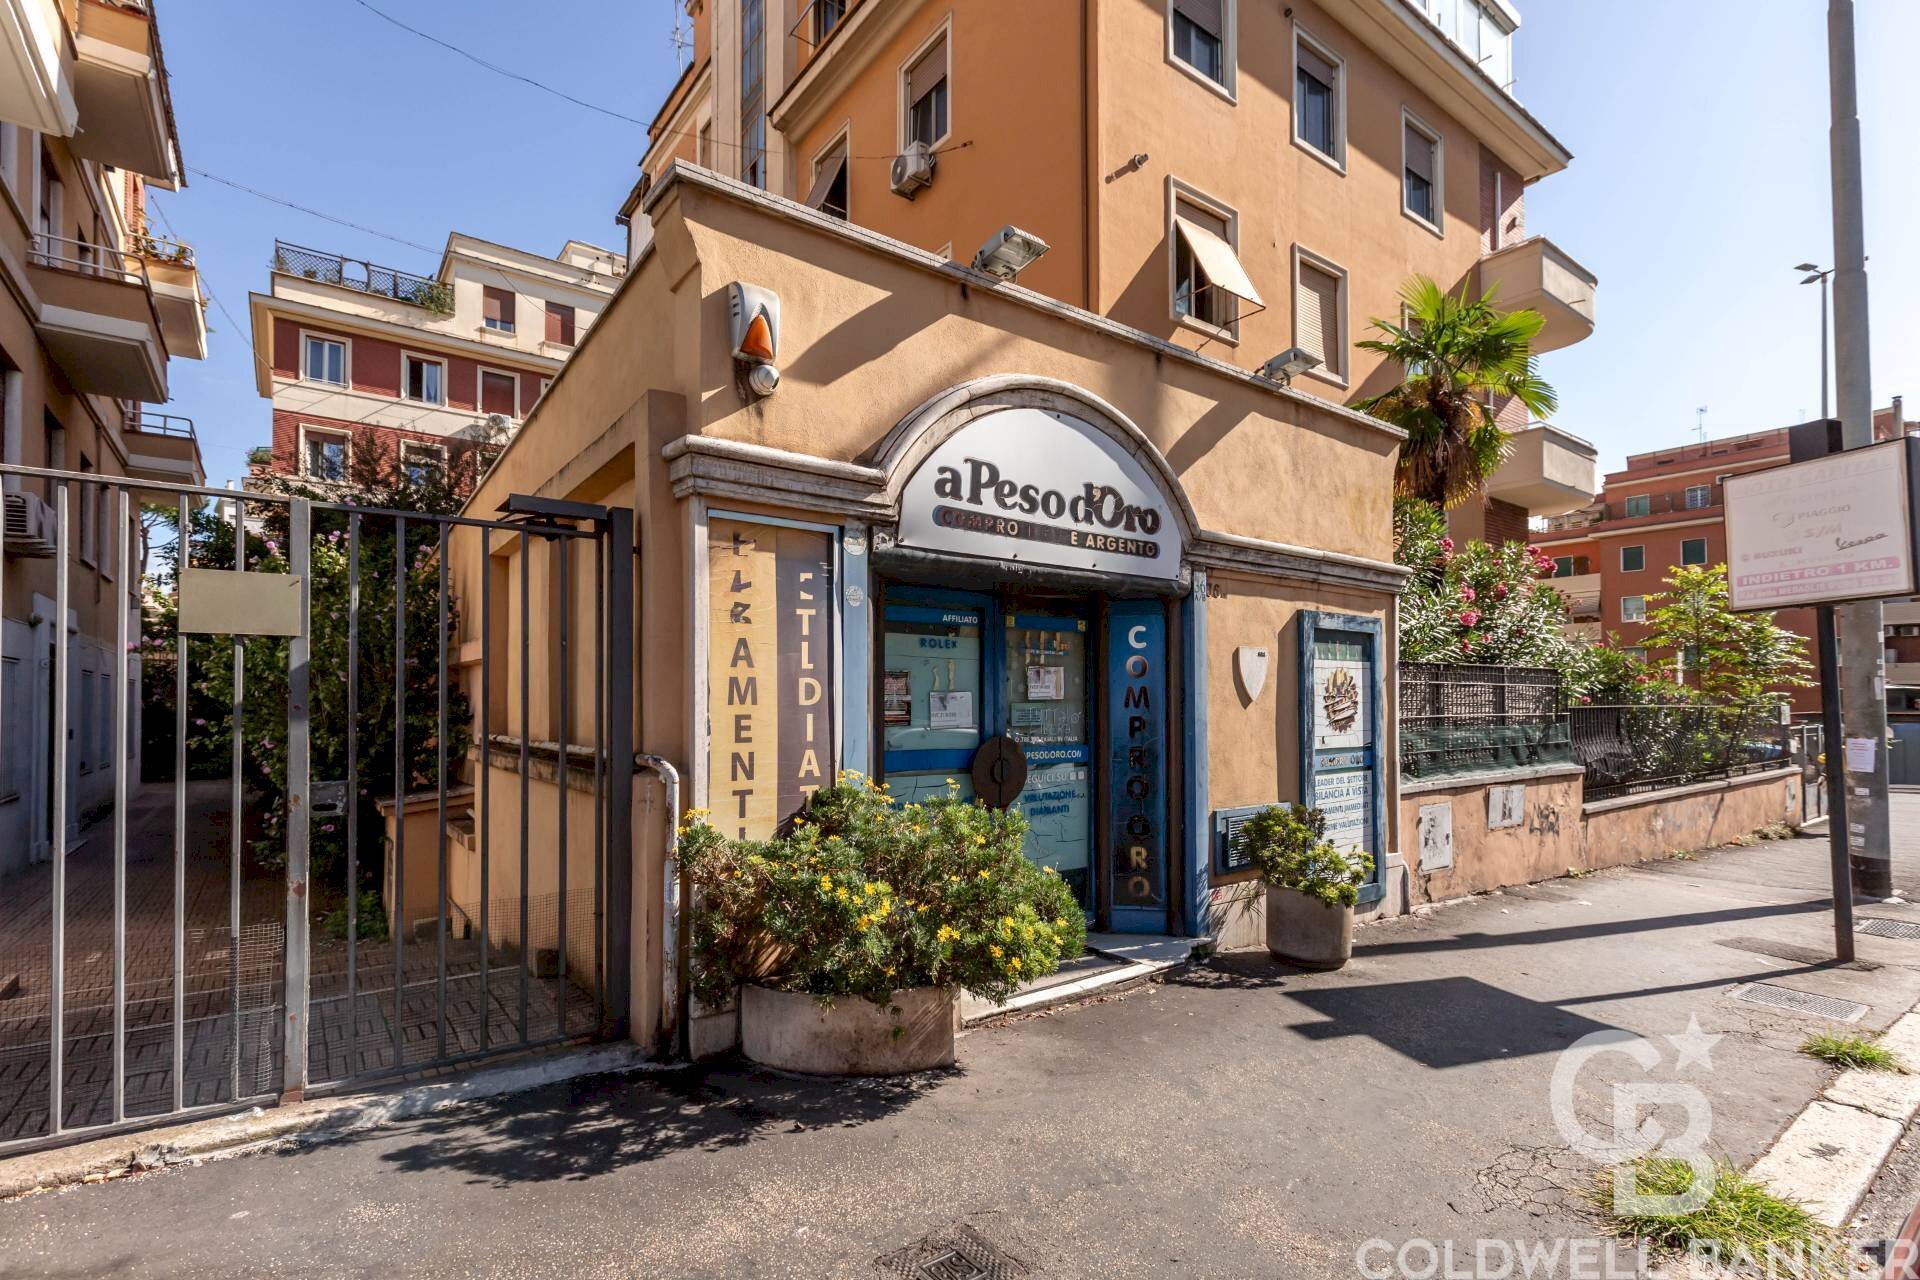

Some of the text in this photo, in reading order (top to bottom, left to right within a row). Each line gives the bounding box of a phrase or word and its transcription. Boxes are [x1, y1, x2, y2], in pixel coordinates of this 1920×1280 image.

[1797, 504, 1851, 520] PIAGGIO
[1070, 531, 1079, 545] E
[1085, 534, 1155, 556] ARGENTO
[1742, 567, 1830, 585] INDIETRO
[1838, 564, 1846, 574] 1
[1853, 559, 1893, 572] KM.
[942, 614, 978, 624] AFFILIATO
[1336, 776, 1346, 785] DEL
[1314, 786, 1369, 801] BILANCIA A VISTA
